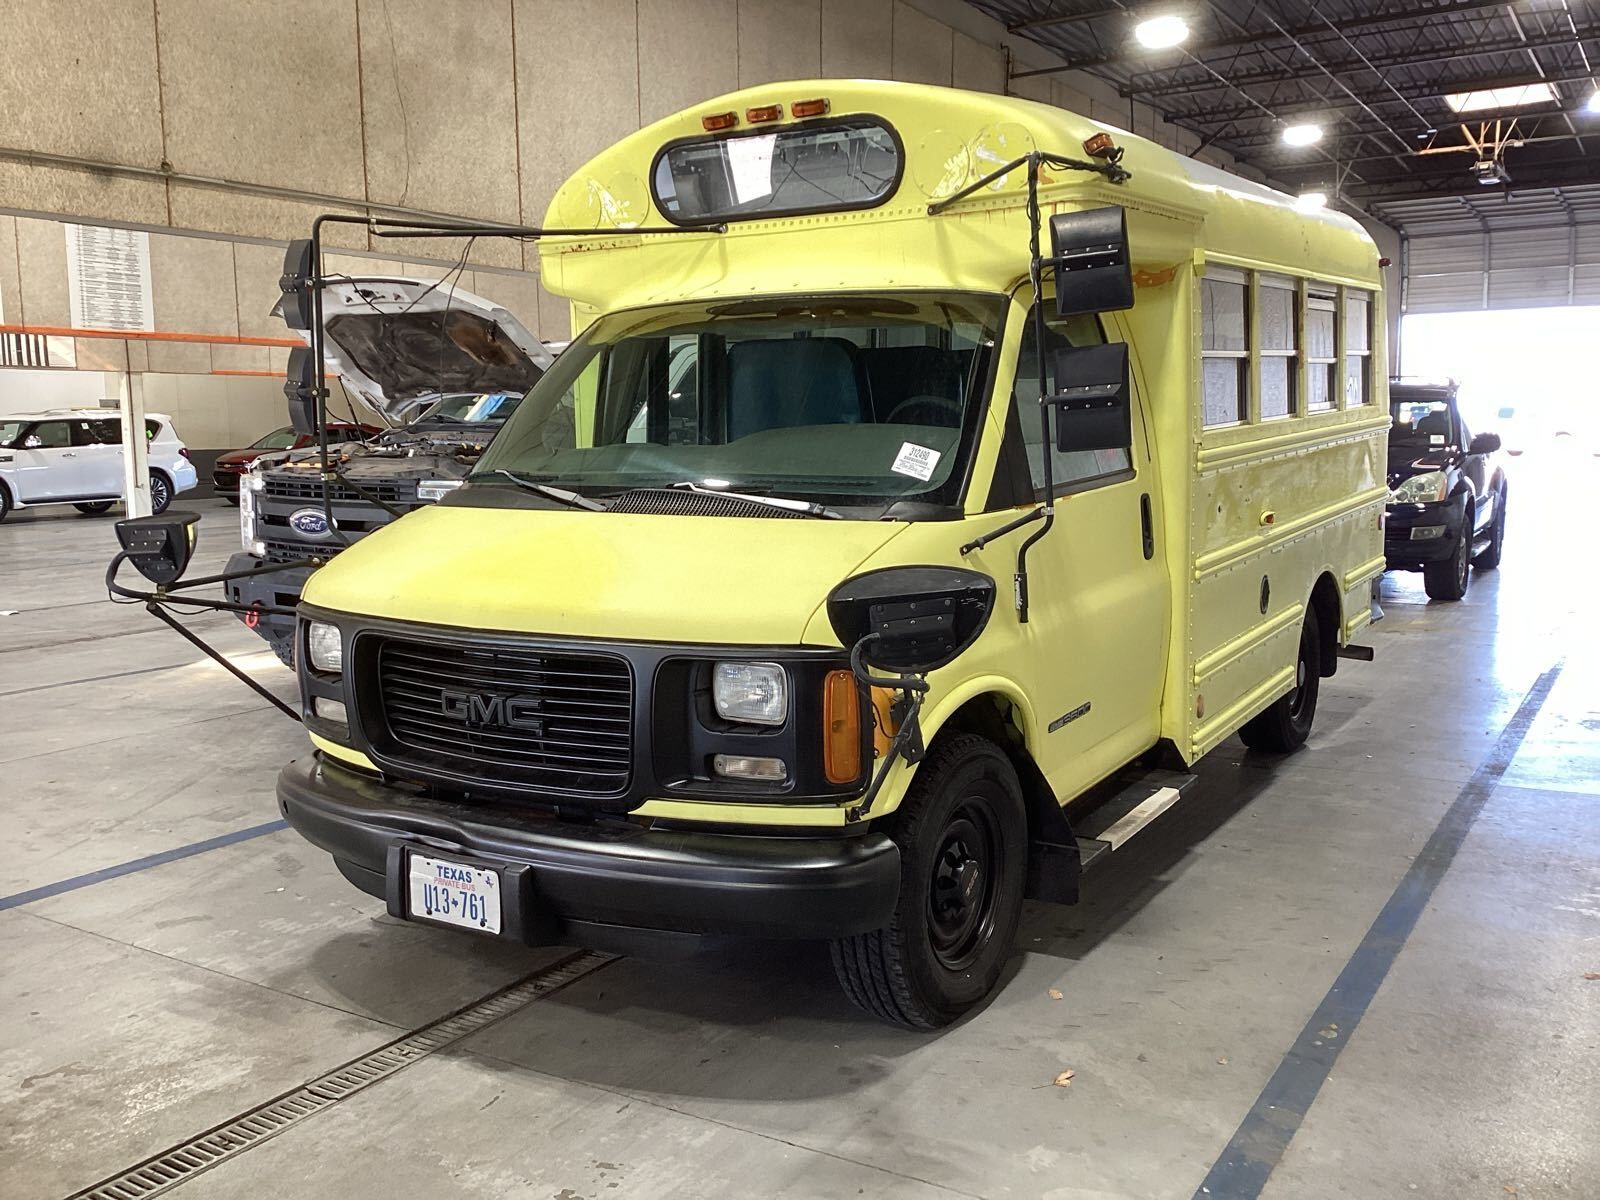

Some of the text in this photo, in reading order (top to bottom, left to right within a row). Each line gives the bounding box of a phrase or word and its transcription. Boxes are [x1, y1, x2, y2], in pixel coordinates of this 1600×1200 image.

[298, 516, 324, 531] Ford
[441, 690, 542, 728] GMC
[436, 864, 473, 884] TEXAS
[433, 876, 476, 892] PRIVATE BUS
